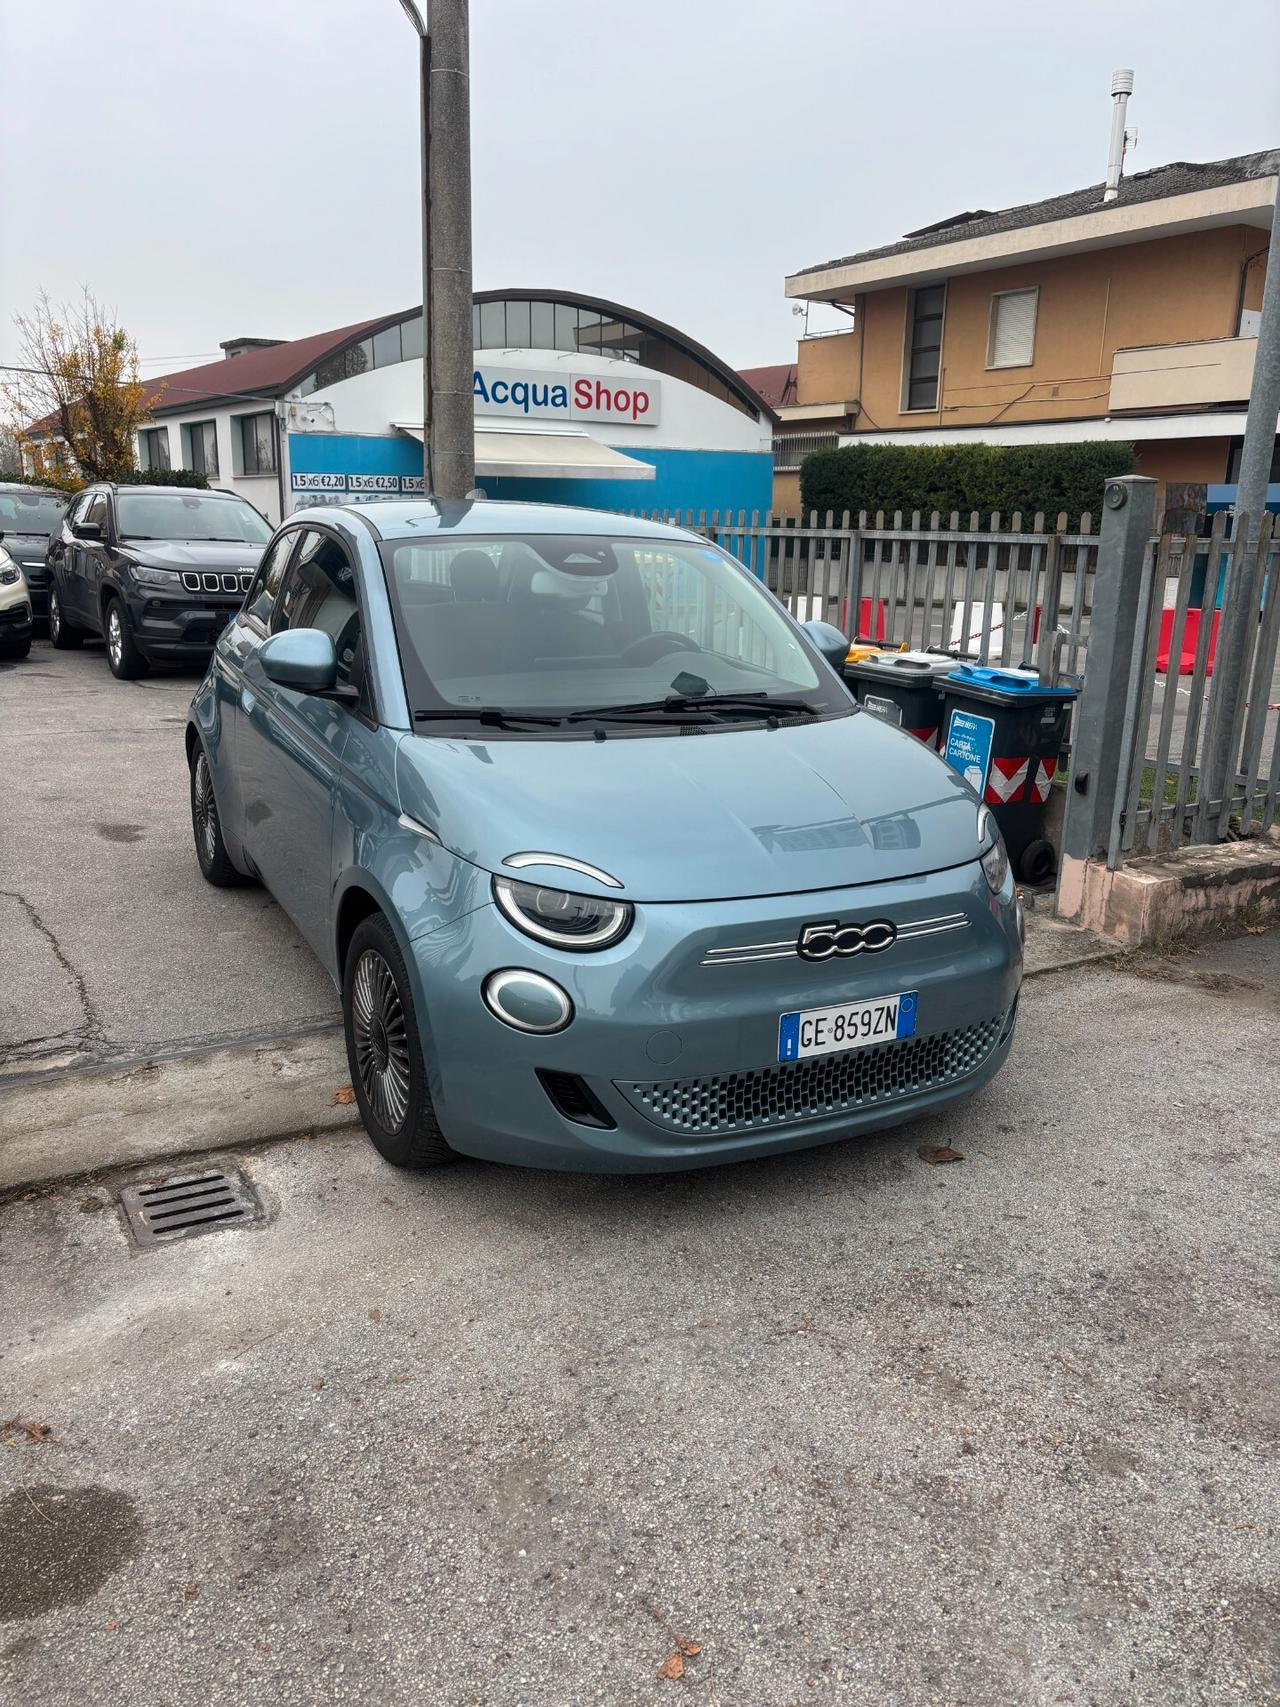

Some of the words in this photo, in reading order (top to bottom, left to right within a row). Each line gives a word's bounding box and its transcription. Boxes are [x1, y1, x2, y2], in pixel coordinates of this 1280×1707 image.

[473, 371, 568, 413] Acqua
[574, 378, 650, 421] Shop
[293, 475, 307, 488] 1,5
[308, 475, 320, 487] x6
[321, 475, 344, 489] €2,20
[349, 476, 362, 489] 1,5
[363, 477, 374, 488] x6
[376, 477, 398, 489] €2,50
[403, 478, 415, 490] 1,5
[949, 747, 981, 764] CARTONE
[802, 924, 894, 958] 500
[801, 1017, 828, 1048] GE
[833, 1004, 898, 1042] 859ZN
